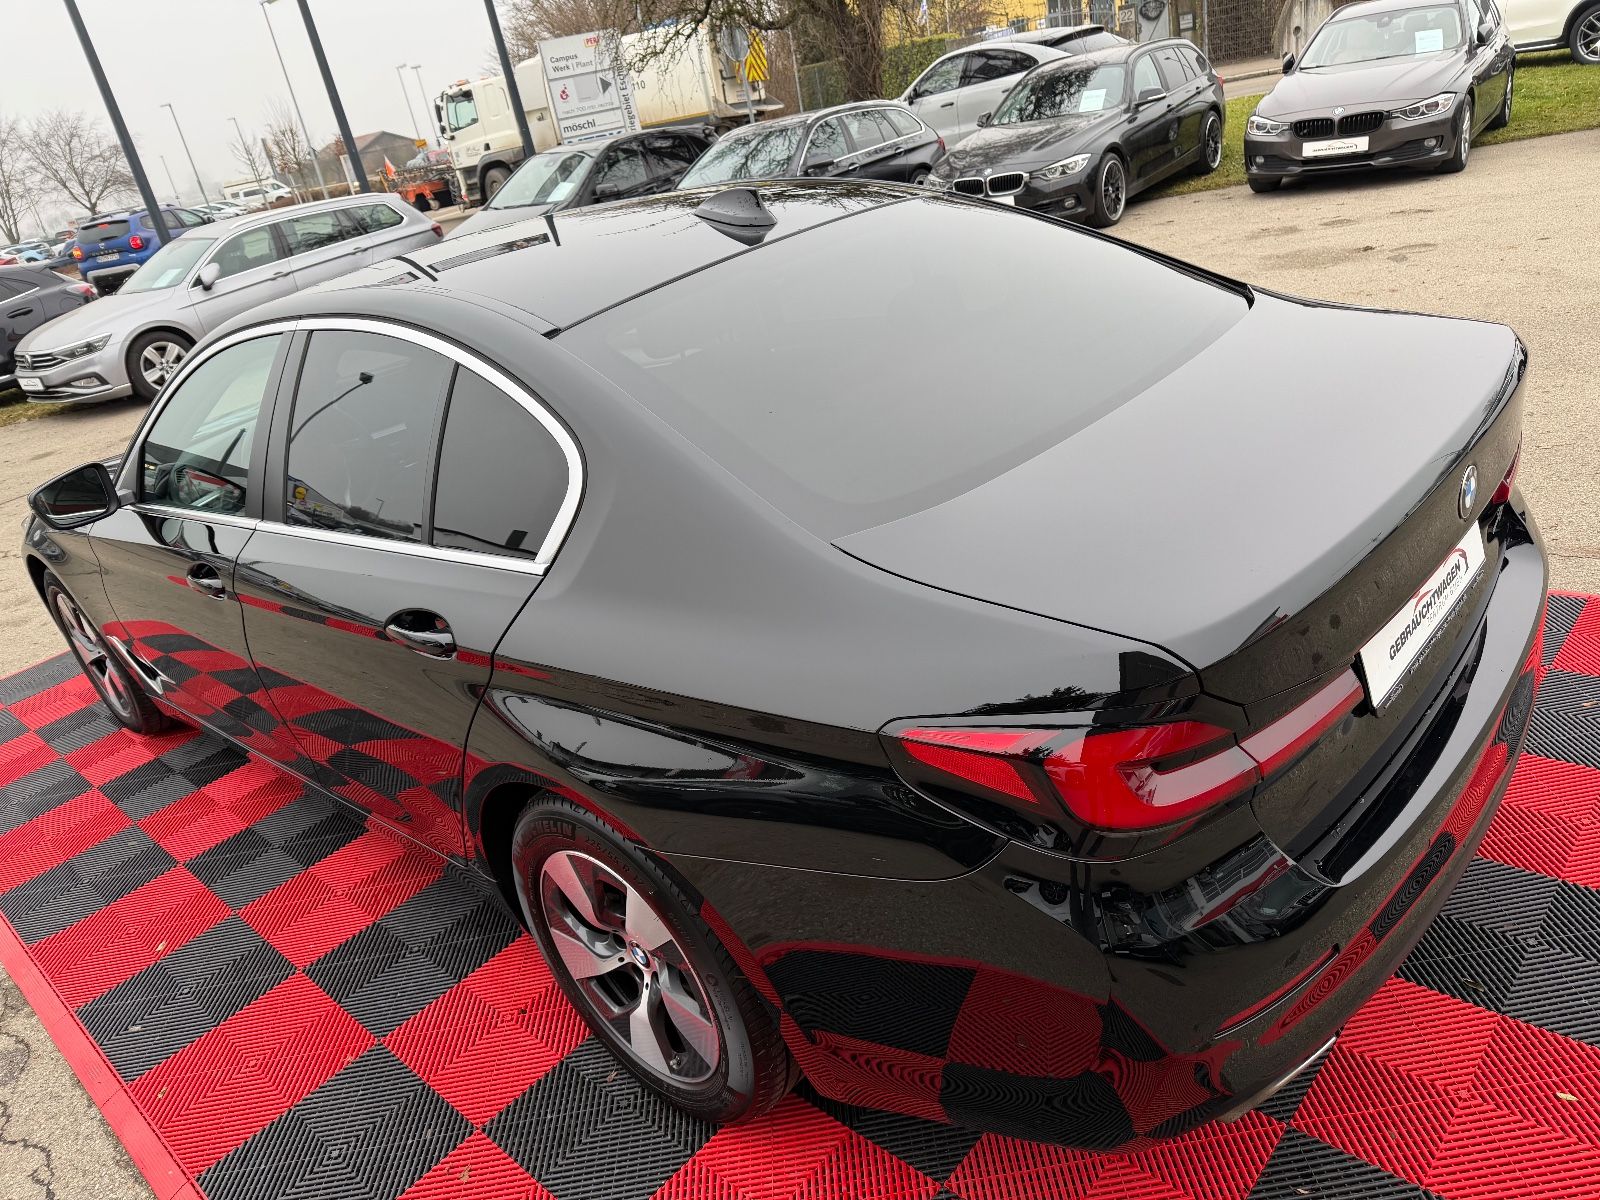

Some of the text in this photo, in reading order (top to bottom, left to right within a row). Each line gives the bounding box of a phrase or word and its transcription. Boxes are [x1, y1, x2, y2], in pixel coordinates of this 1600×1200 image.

[1120, 9, 1133, 21] 22
[550, 53, 578, 63] Campus
[551, 60, 593, 73] Werk Plant
[622, 93, 637, 131] riegebiet
[563, 118, 596, 133] möschl
[1389, 559, 1461, 660] GEBRAUCHTWAGEN
